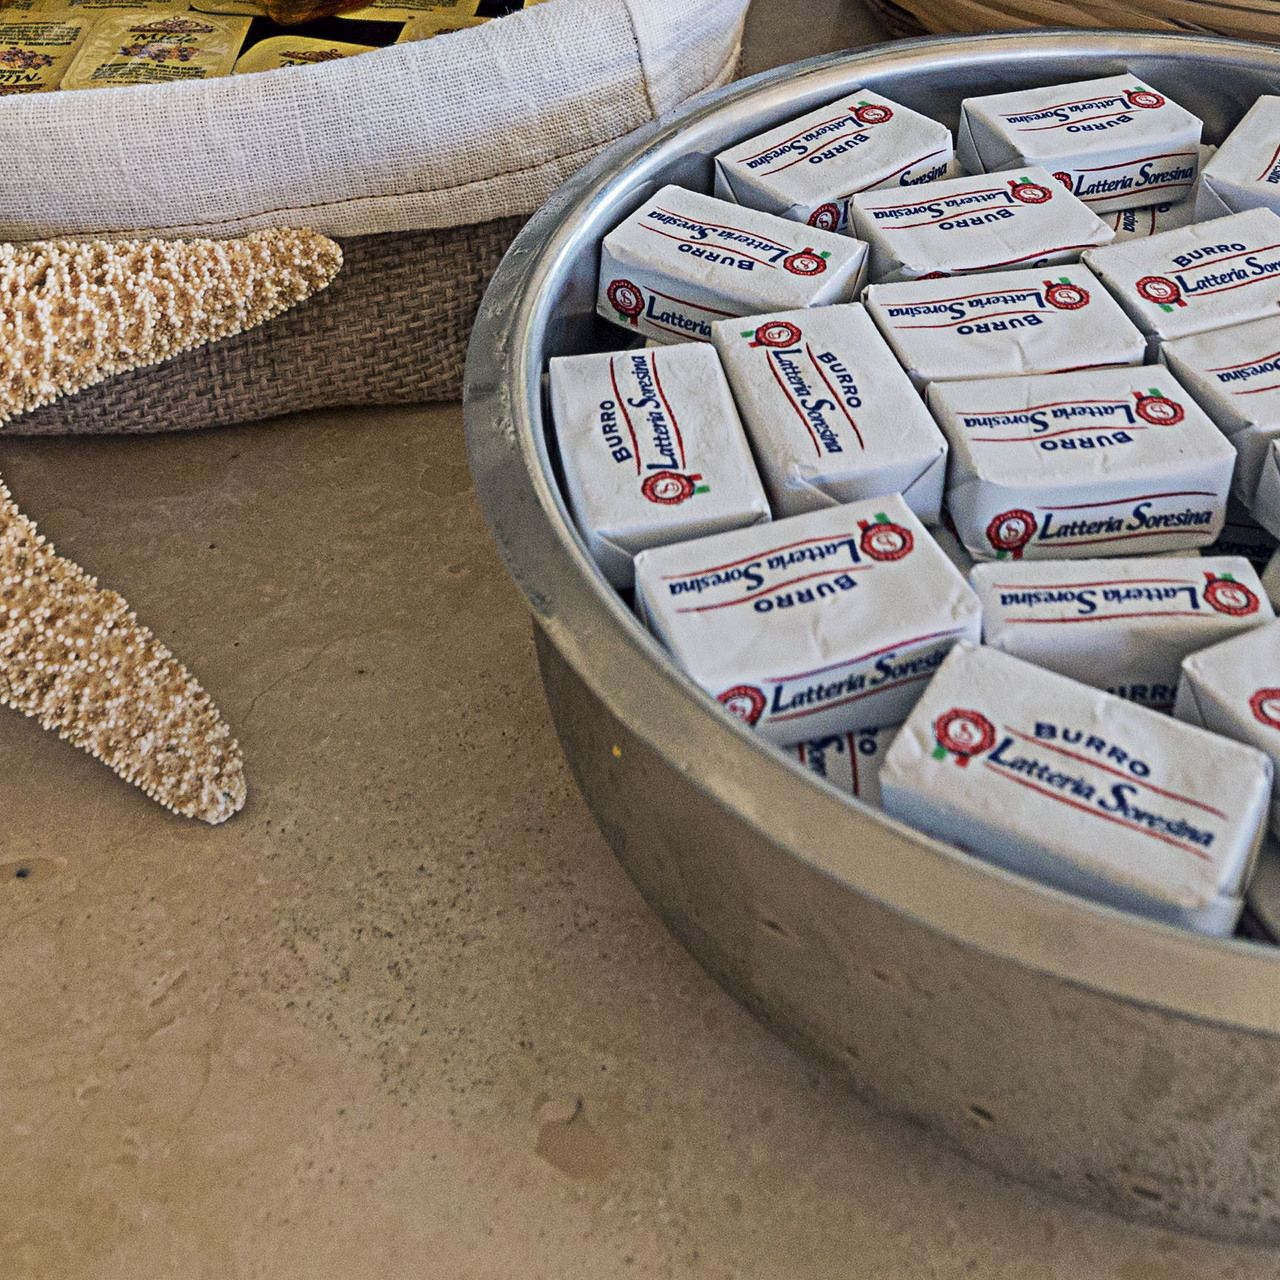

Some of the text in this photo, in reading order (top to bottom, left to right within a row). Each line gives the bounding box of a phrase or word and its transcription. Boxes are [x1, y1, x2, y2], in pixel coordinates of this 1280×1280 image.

[1006, 95, 1132, 124] Latteria Soresina
[1066, 114, 1133, 133] BURRO
[746, 116, 864, 170] Latteria Soresina
[809, 133, 870, 164] BURRO
[1073, 162, 1194, 198] Latteria Soresina
[873, 190, 1014, 220] Latteria Soresina
[938, 208, 1015, 230] BURRO
[647, 210, 789, 263] Latteria Soresina
[678, 243, 755, 271] BURRO
[1172, 242, 1247, 268] BURRO
[1174, 267, 1250, 293] Latteria
[646, 295, 712, 337] Latteria
[888, 289, 1045, 320] Latteria Soresina
[956, 314, 1043, 335] BURRO
[817, 351, 862, 409] BURRO
[627, 355, 679, 471] Latteria Soresina
[772, 347, 843, 454] Latteria Soresina
[964, 403, 1136, 432] Latteria Soresina
[599, 399, 634, 464] BURRO
[1040, 431, 1135, 451] BURRO
[1037, 502, 1214, 541] Latteria Soresina
[669, 538, 862, 596] Latteria Soresina
[754, 575, 858, 613] BURRO
[1000, 587, 1200, 614] Latteria Soresina
[770, 676, 866, 714] Latteria
[1034, 722, 1151, 778] BURRO
[987, 737, 1215, 848] Latteria Soresina
